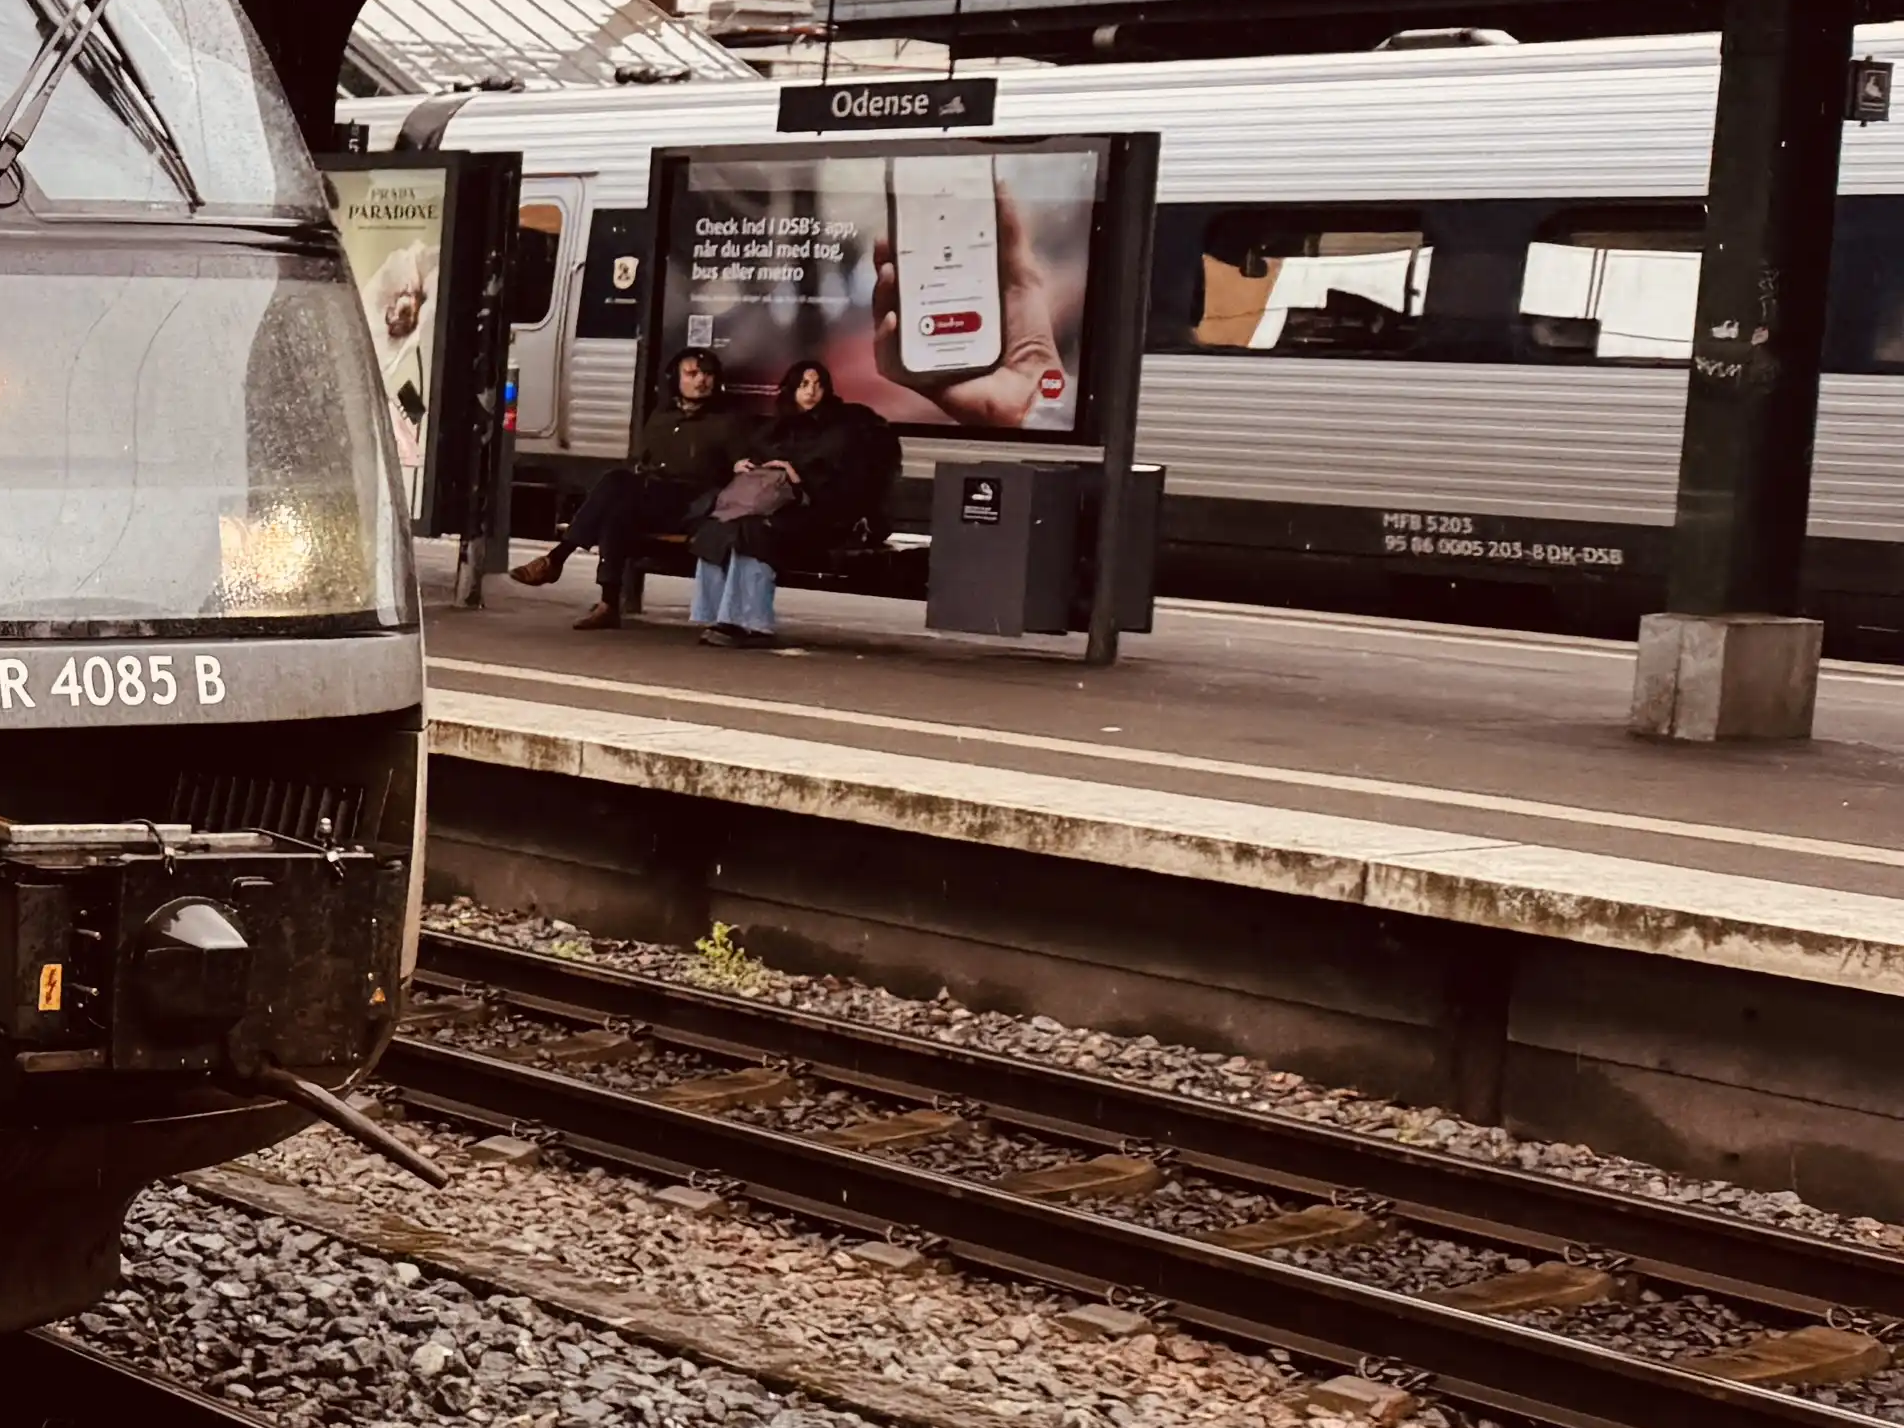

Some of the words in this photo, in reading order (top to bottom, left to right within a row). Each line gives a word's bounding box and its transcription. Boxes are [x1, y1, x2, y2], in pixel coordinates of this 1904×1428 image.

[831, 89, 929, 118] Odense
[696, 217, 739, 236] Check
[777, 217, 821, 236] DSB's
[721, 240, 740, 258] du
[743, 239, 773, 259] skal
[776, 239, 811, 259] med
[692, 262, 718, 280] bus
[722, 262, 755, 280] eller
[757, 264, 804, 281] metro
[1427, 516, 1473, 534] 5203
[50, 655, 177, 706] 4085
[195, 655, 226, 705] B
